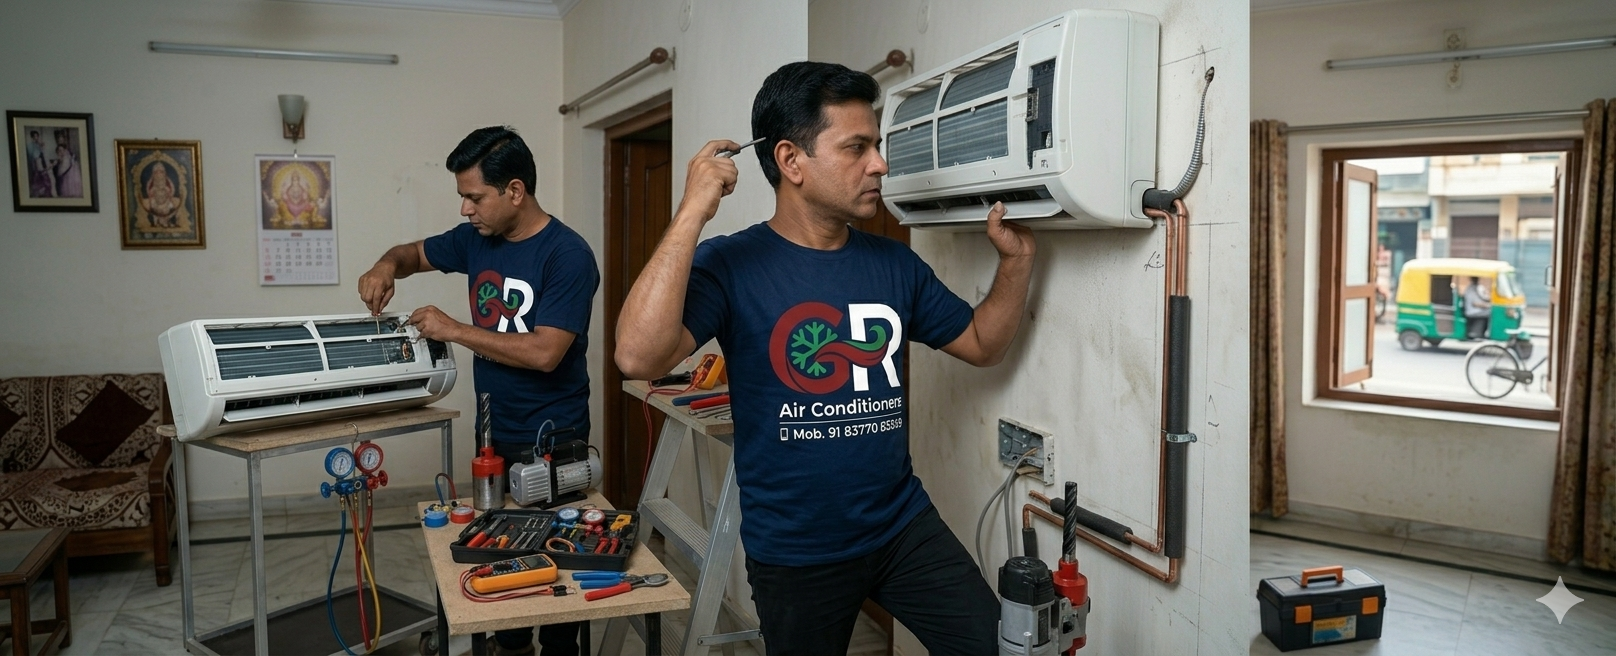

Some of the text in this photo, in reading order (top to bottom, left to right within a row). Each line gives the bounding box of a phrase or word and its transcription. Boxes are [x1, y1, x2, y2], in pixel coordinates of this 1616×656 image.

[779, 402, 806, 418] Air
[793, 428, 825, 440] Mob.
[828, 426, 840, 438] 91
[844, 422, 878, 437] 83770
